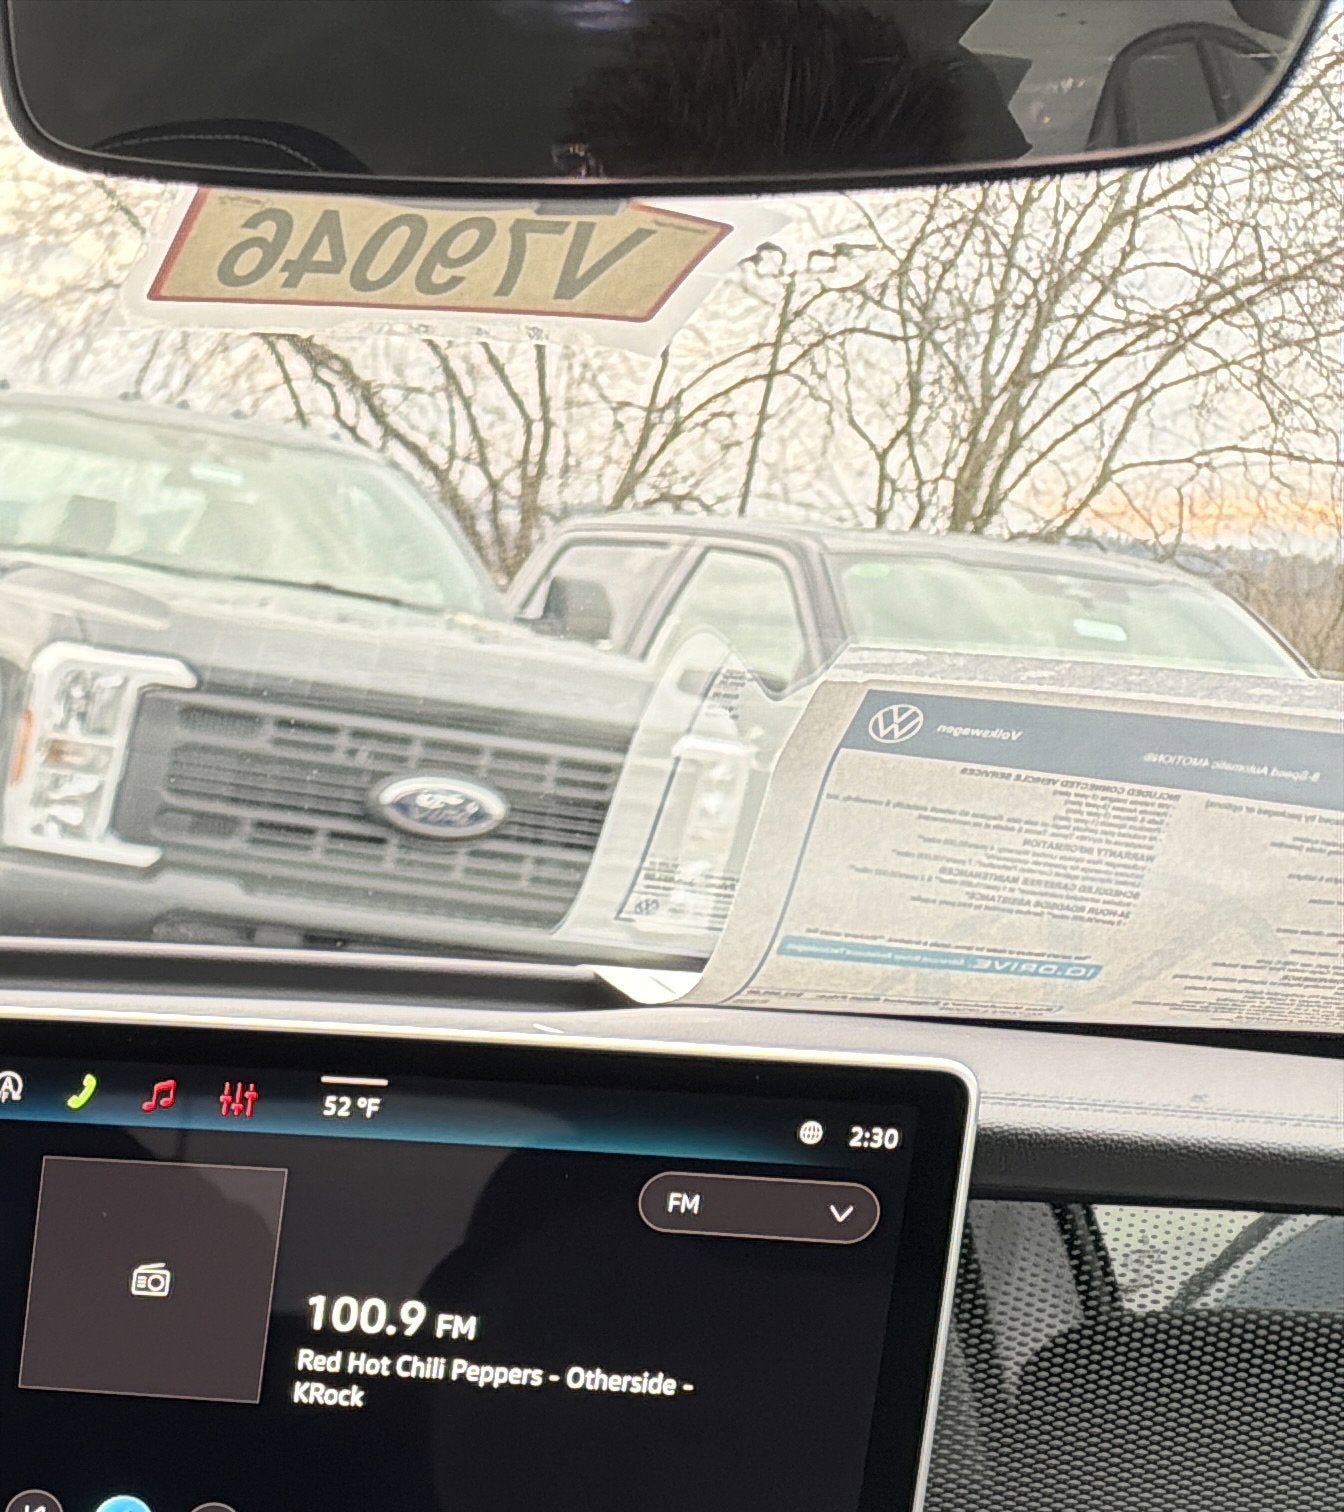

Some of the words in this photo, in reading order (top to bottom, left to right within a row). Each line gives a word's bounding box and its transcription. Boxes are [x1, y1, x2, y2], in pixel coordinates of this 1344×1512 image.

[322, 1095, 352, 1117] 52
[848, 1126, 900, 1150] 2:30
[667, 1193, 701, 1216] FM
[308, 1294, 427, 1337] 100.9
[435, 1313, 477, 1341] FM
[297, 1348, 341, 1374] Red
[347, 1351, 390, 1378] Hot
[395, 1354, 446, 1380] Chili
[450, 1358, 544, 1390] Peppers
[566, 1366, 677, 1396] Otherside
[293, 1381, 364, 1408] KRock
